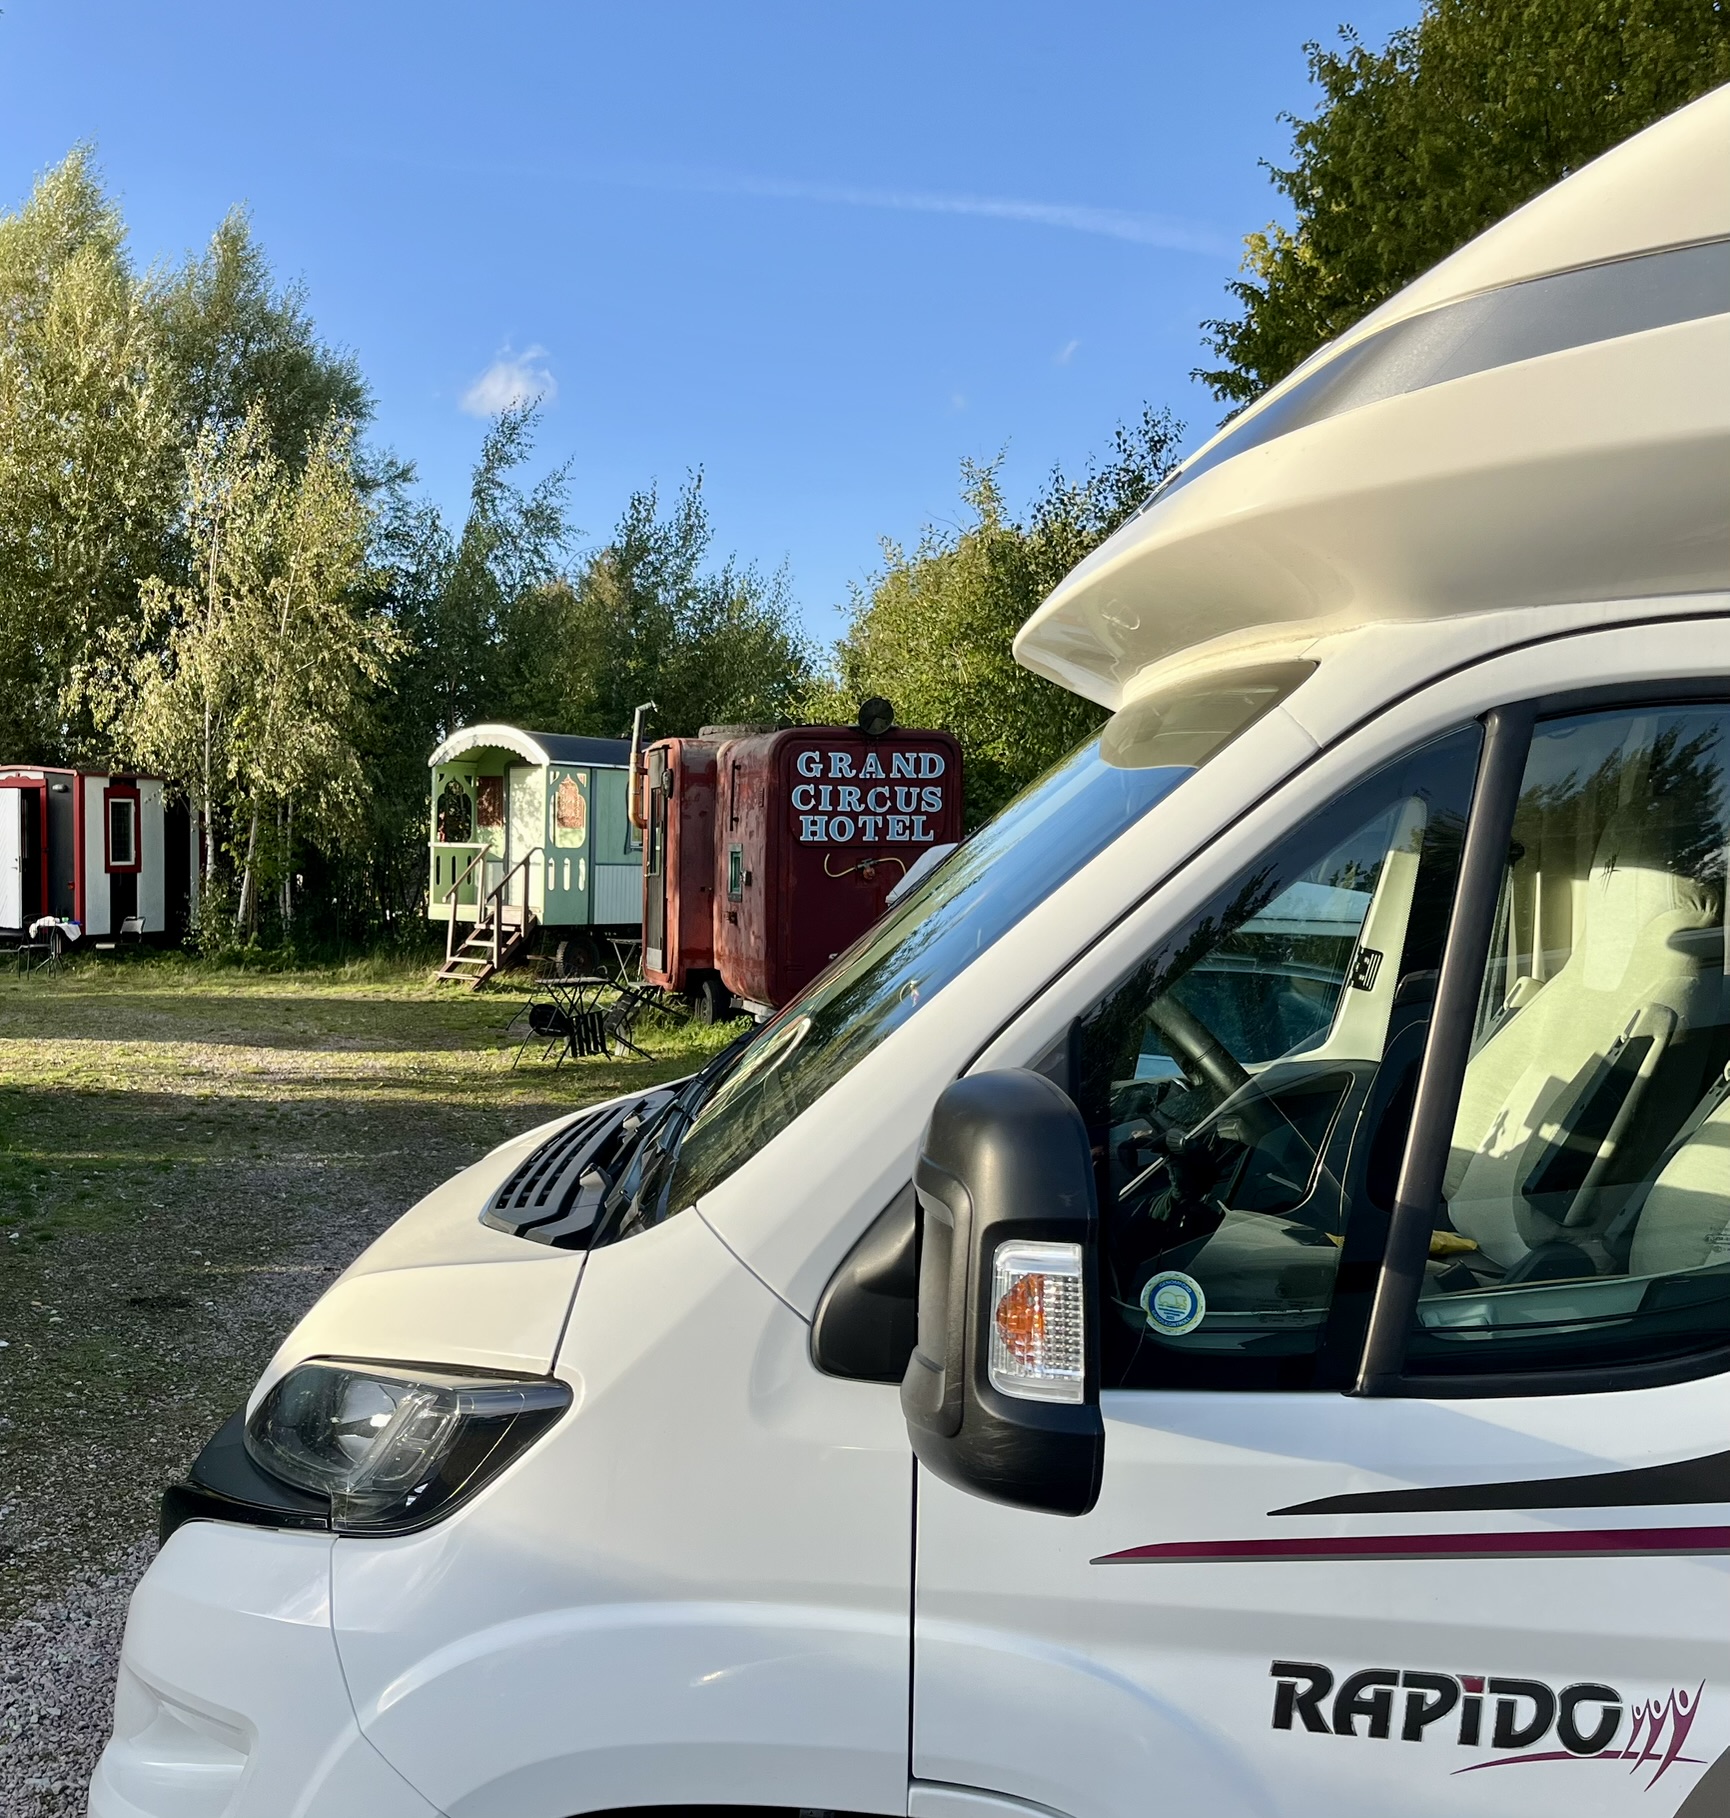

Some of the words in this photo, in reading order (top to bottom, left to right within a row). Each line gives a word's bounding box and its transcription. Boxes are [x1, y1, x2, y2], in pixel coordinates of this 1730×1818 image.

[797, 751, 945, 779] GRAND
[791, 784, 943, 813] CIRCUS
[799, 815, 935, 842] HOTEL
